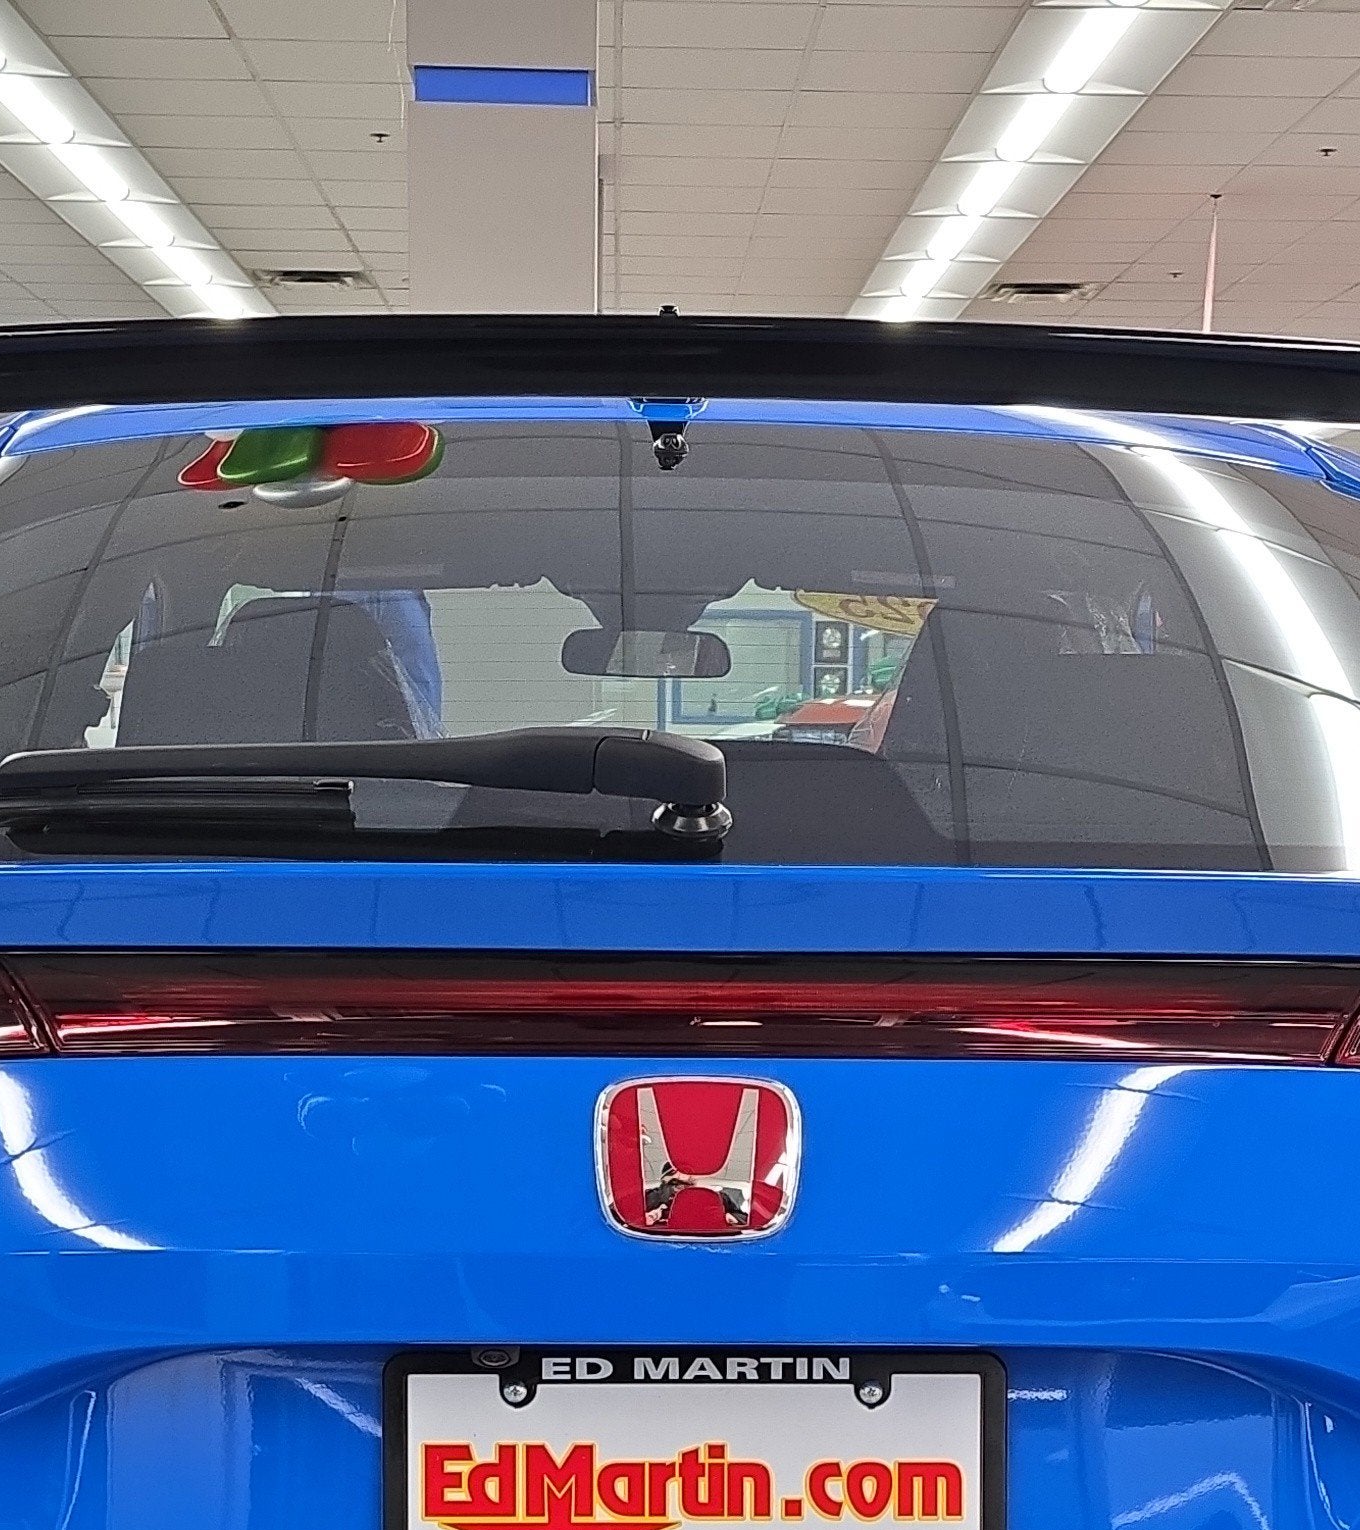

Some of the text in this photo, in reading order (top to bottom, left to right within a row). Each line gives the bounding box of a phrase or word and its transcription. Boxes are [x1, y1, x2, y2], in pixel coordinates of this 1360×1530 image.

[541, 1357, 851, 1381] ED MARTIN
[420, 1441, 965, 1523] EdMartin.com
